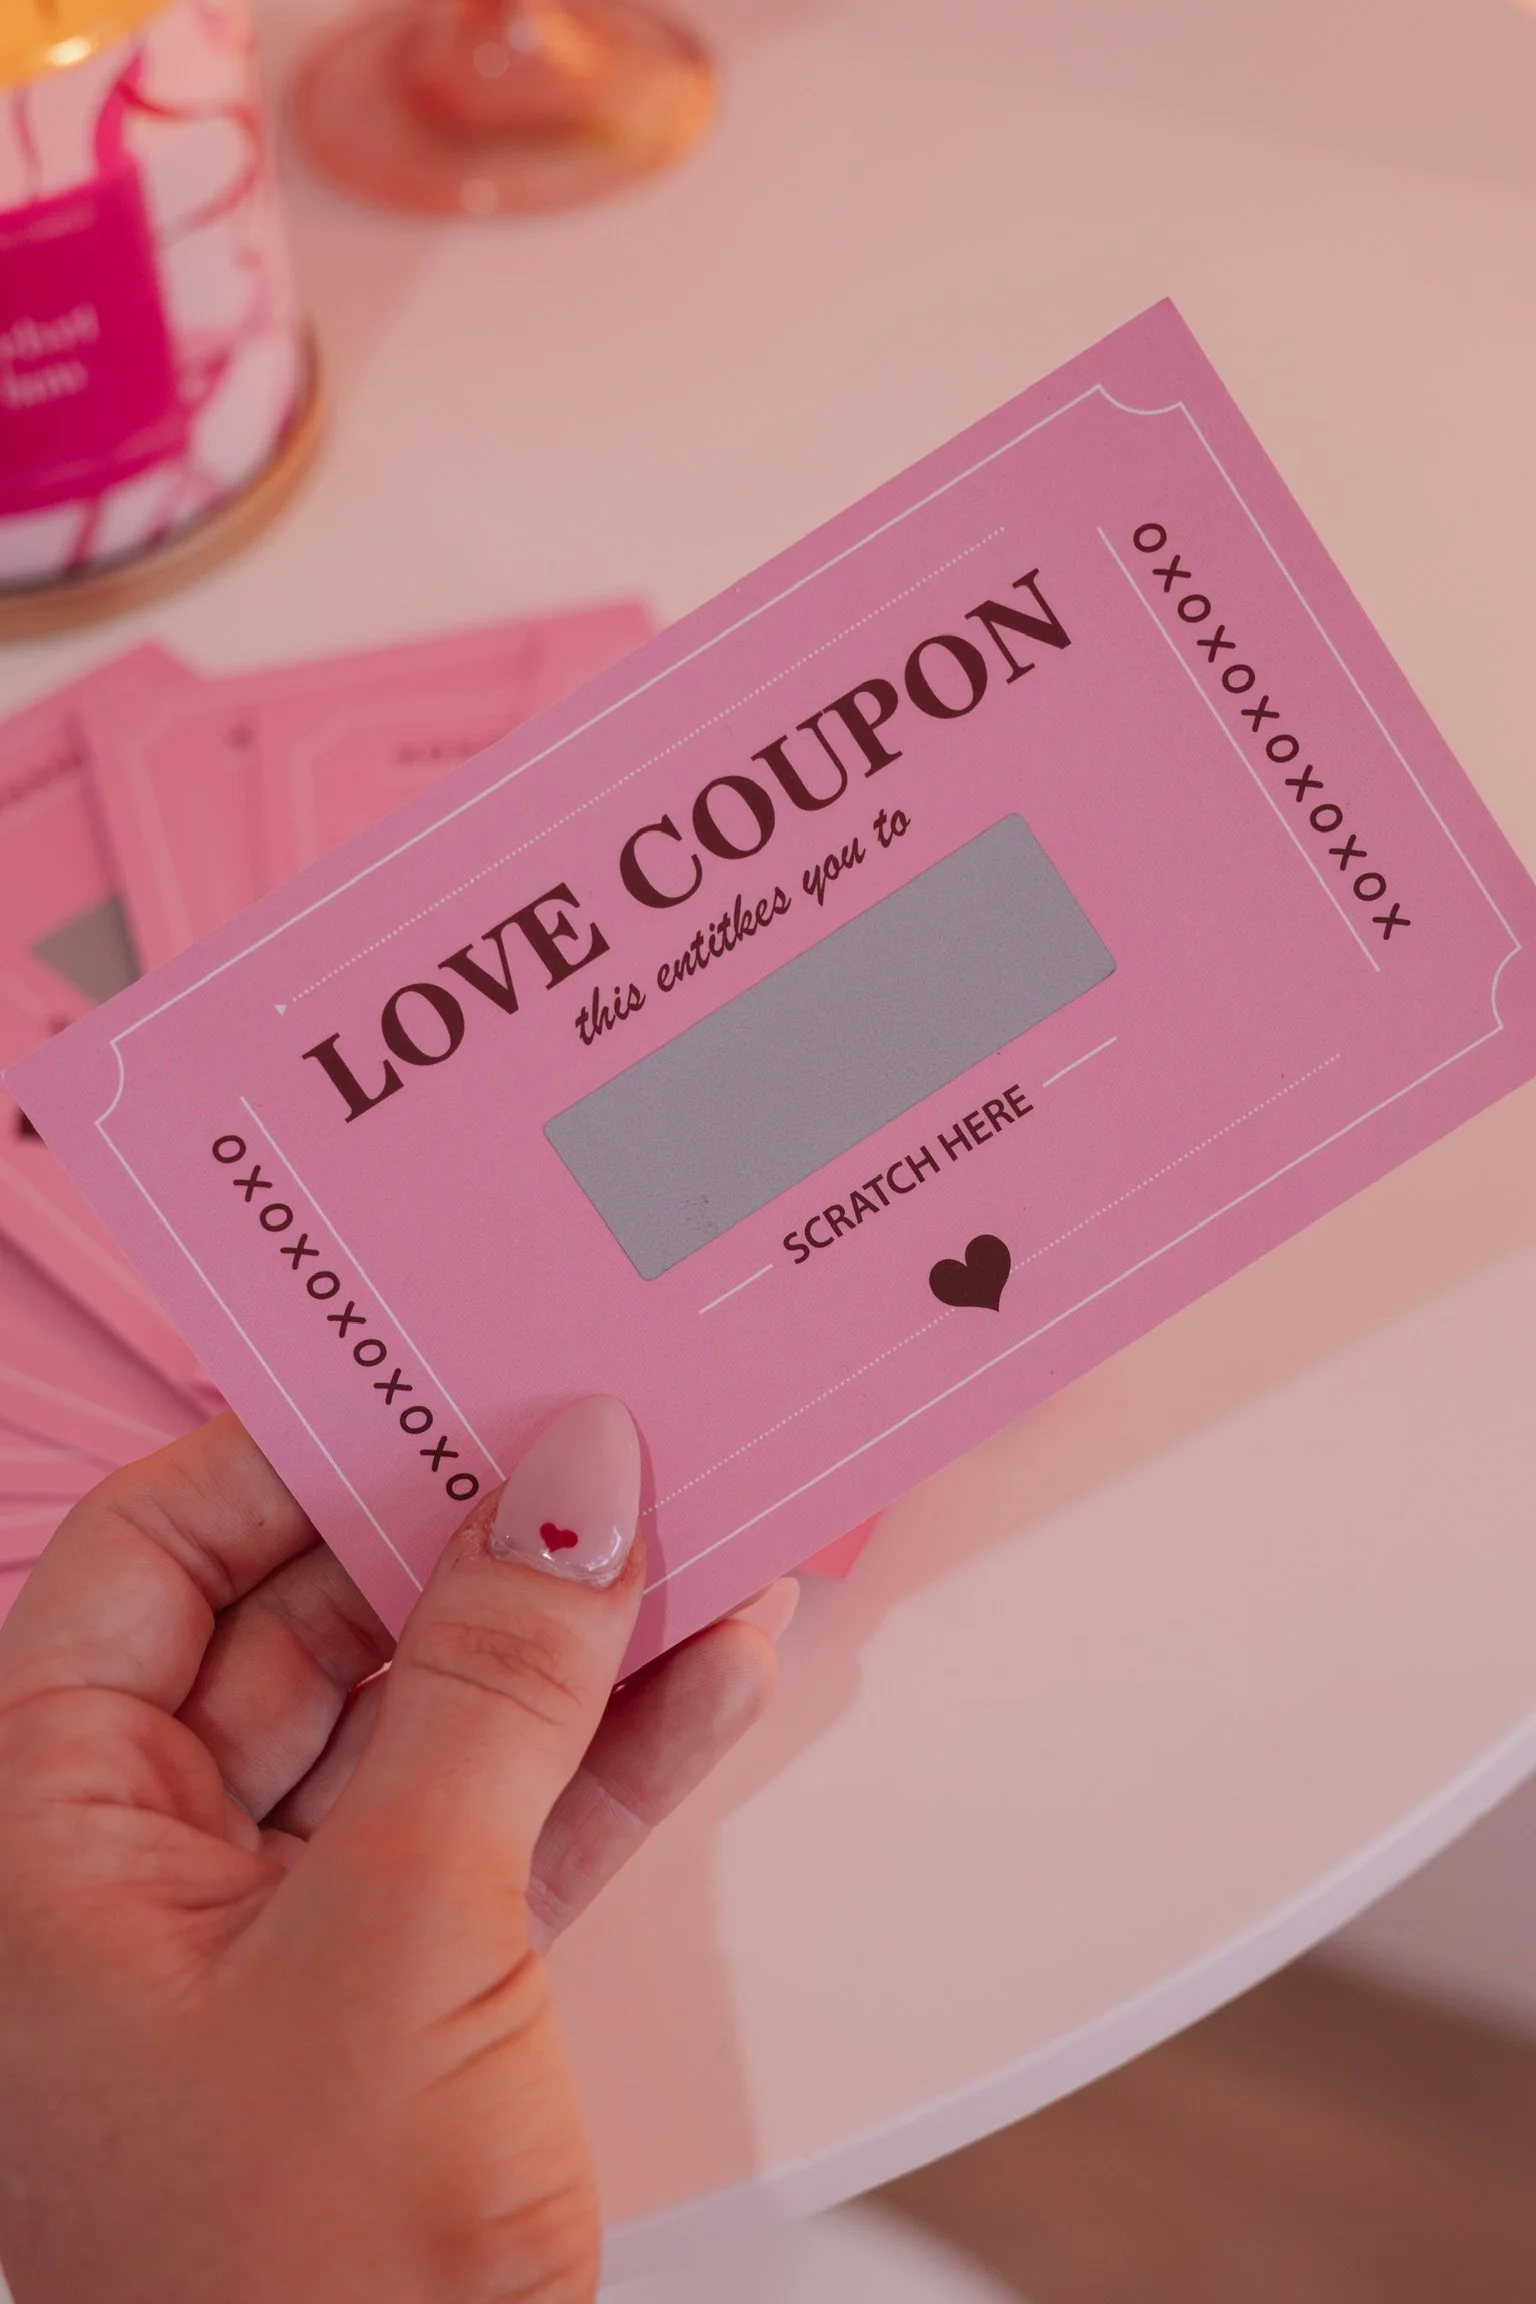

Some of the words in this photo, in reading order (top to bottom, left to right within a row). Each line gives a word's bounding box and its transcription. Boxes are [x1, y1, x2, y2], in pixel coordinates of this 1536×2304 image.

[302, 883, 610, 1123] LOVE
[620, 568, 1071, 908] COUPON
[575, 983, 646, 1045] this
[803, 837, 865, 906] you
[873, 809, 911, 848] to
[783, 1146, 940, 1264] SCRATCH
[937, 1084, 1033, 1161] HERE
